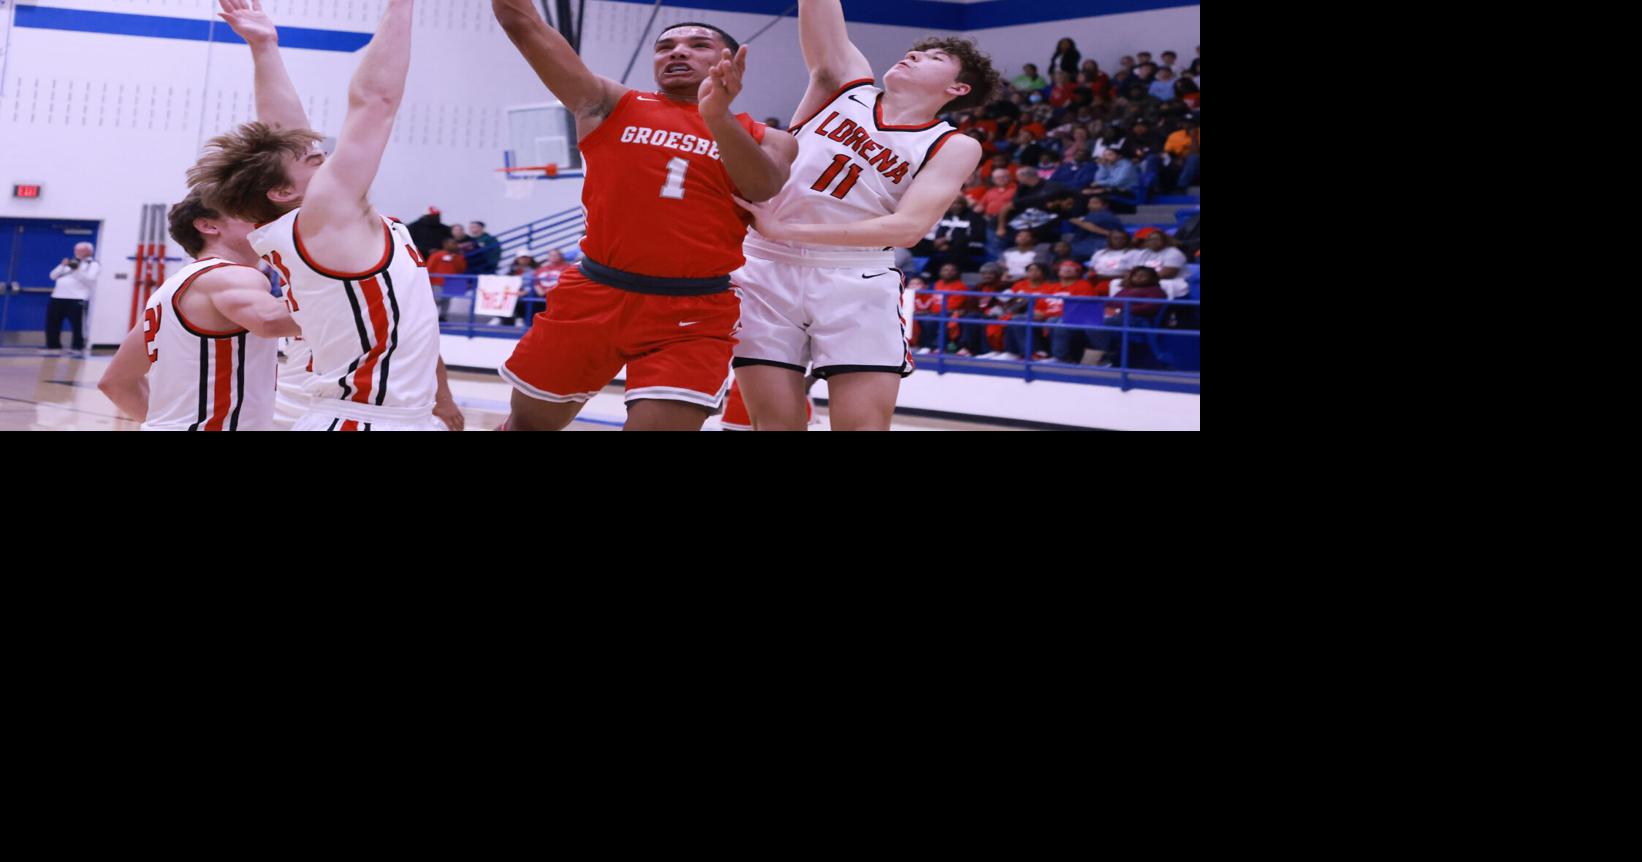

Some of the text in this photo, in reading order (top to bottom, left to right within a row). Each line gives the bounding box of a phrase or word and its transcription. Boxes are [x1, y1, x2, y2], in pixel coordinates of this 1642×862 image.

[815, 111, 910, 184] LORENA
[660, 156, 689, 200] 1
[810, 153, 864, 199] 11
